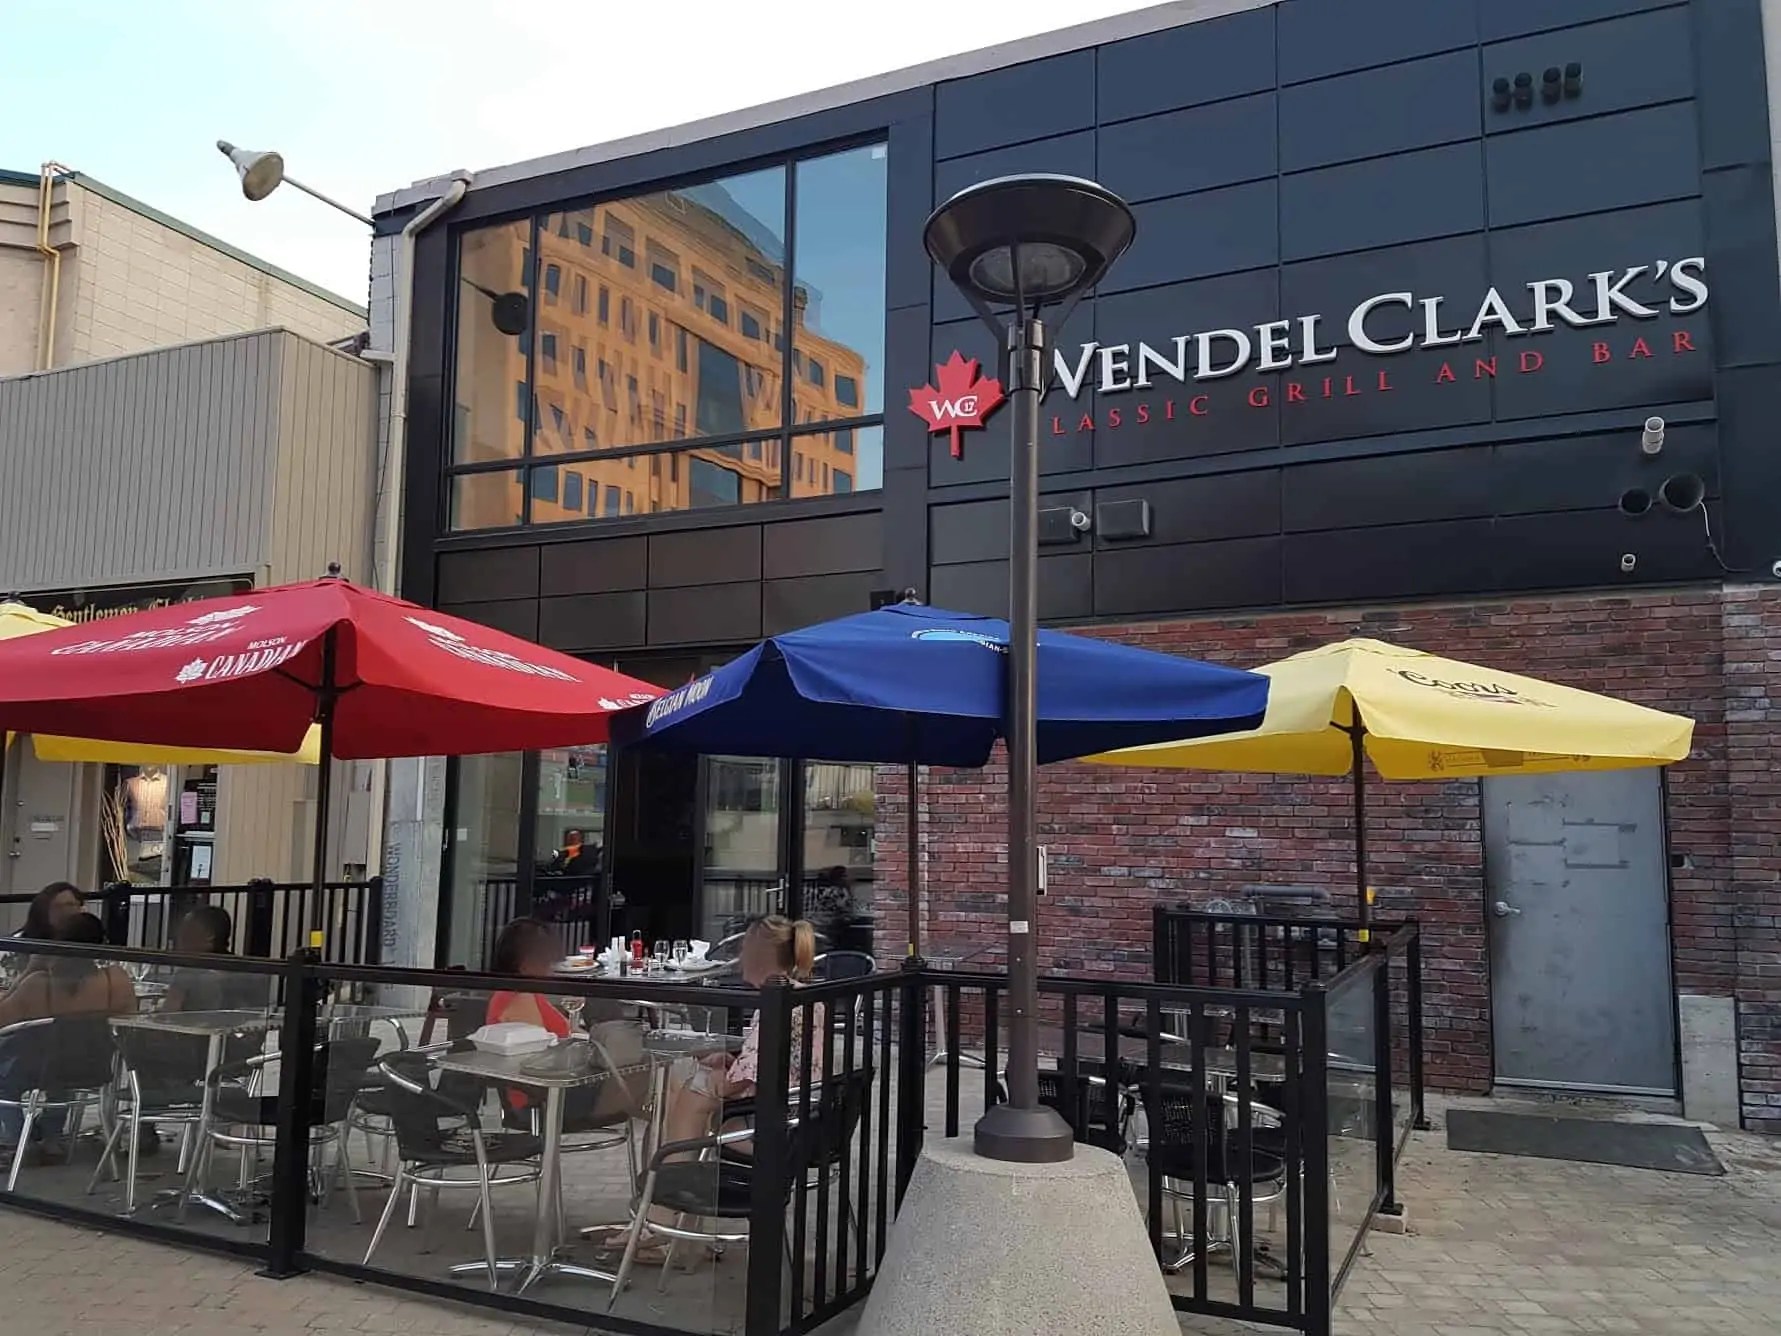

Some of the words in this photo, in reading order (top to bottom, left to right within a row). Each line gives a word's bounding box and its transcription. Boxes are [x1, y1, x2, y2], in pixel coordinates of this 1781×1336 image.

[1348, 257, 1709, 354] CLARK'S
[1052, 395, 1209, 435] LASSIC
[1249, 371, 1393, 407] GRILL
[1437, 351, 1544, 385] AND
[1592, 330, 1696, 364] BAR
[205, 640, 308, 679] CANADIAN
